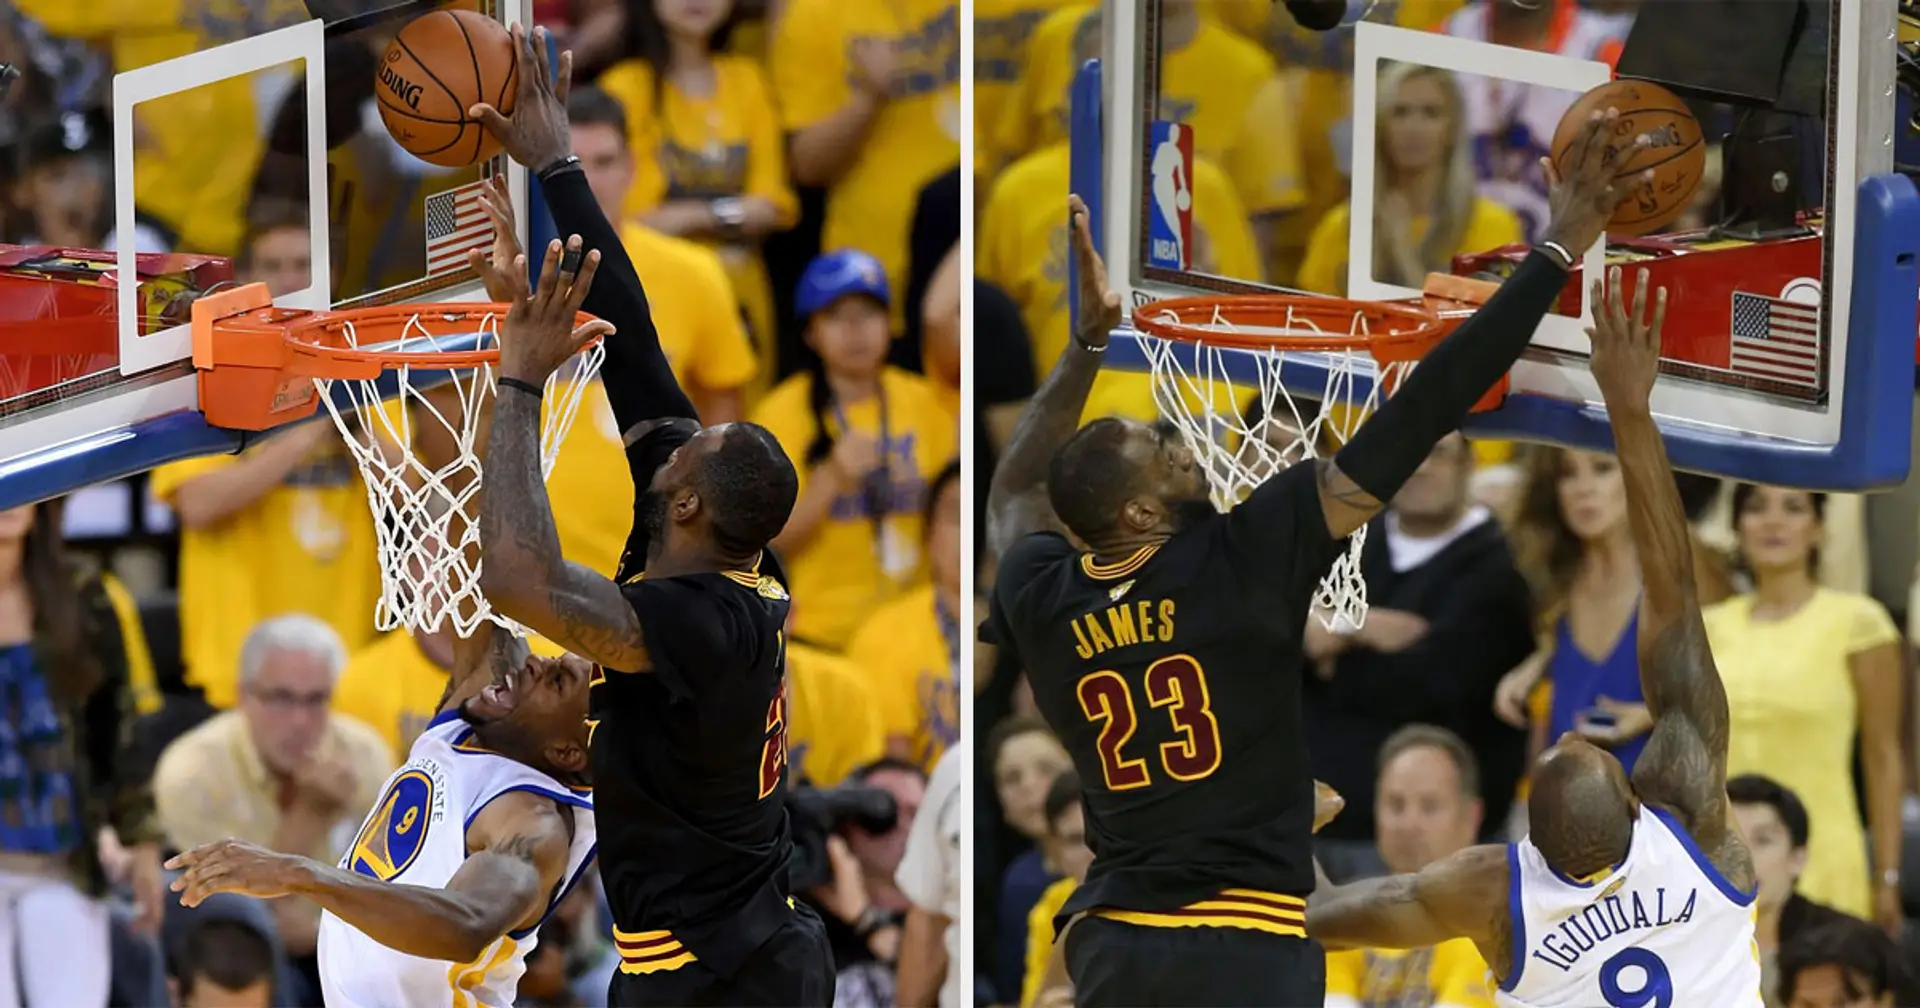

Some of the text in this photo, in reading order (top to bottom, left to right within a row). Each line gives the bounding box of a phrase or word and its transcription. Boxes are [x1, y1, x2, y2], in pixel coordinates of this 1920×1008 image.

[1153, 239, 1178, 261] NBA
[1070, 599, 1175, 659] JAMES
[1076, 654, 1222, 790] 23
[395, 806, 419, 835] 9
[1532, 888, 1697, 971] IGUODALA
[1599, 946, 1673, 1008] 9
